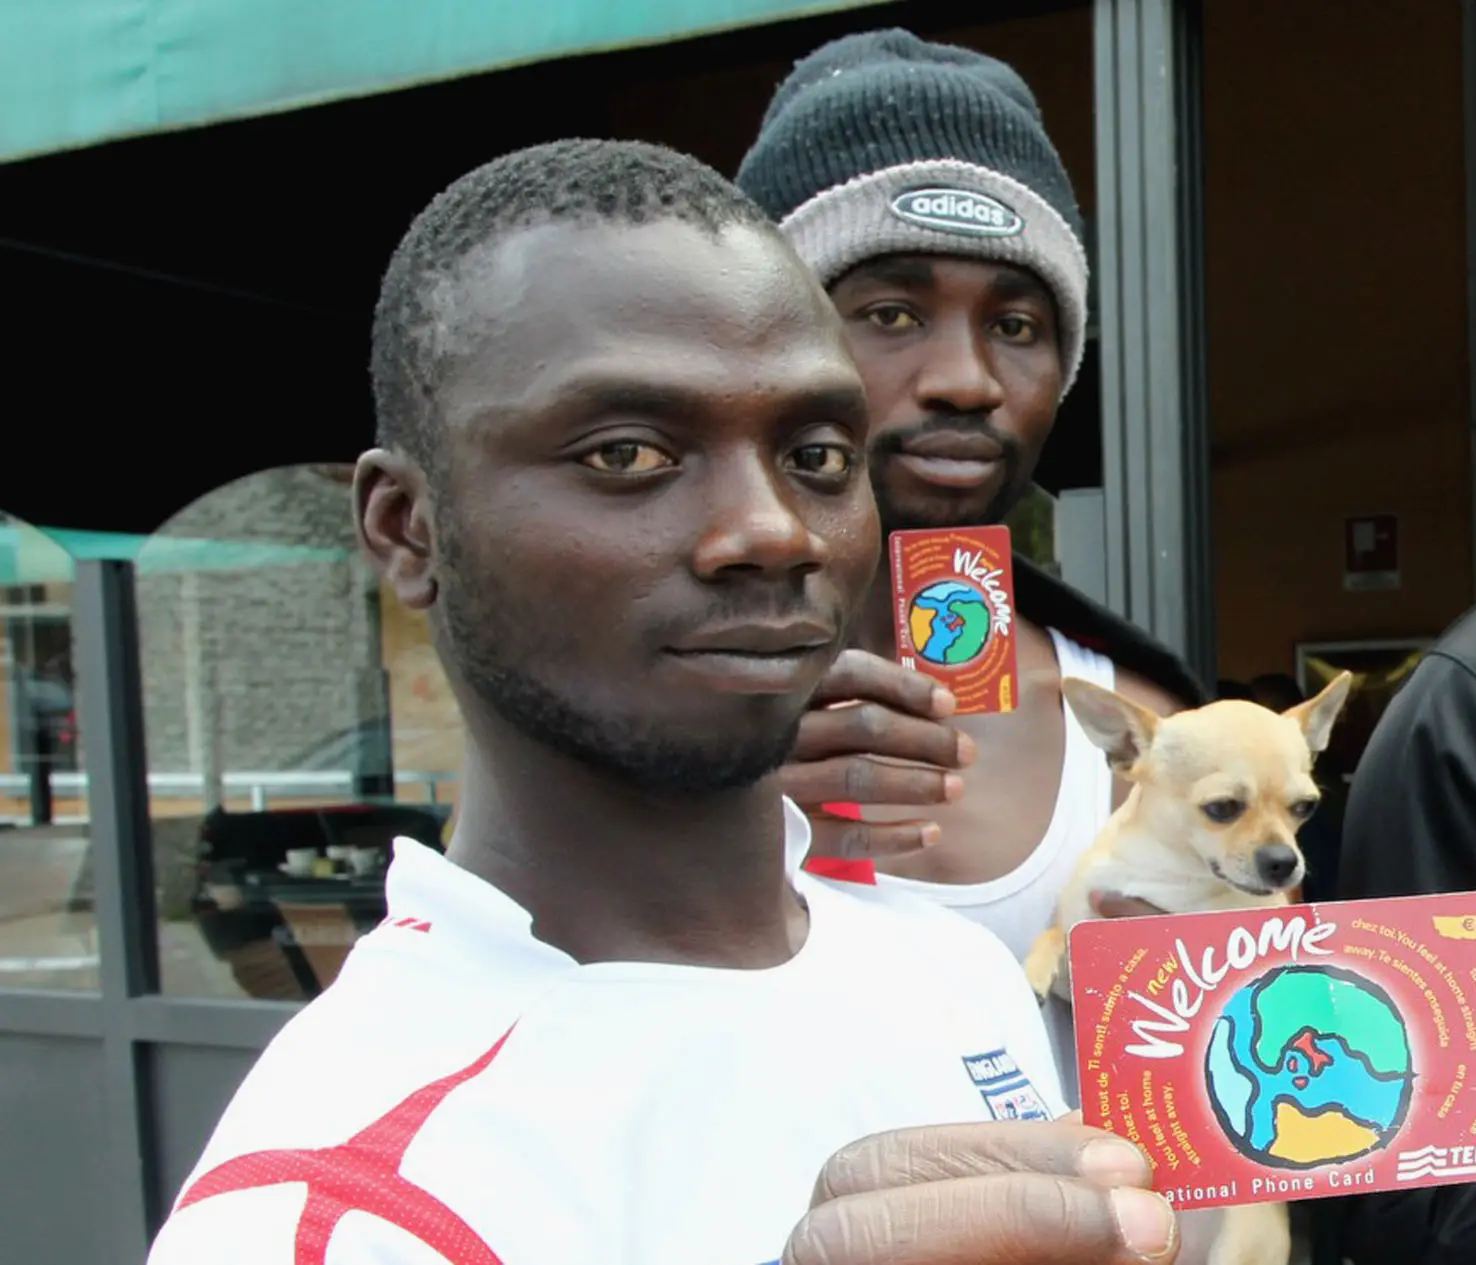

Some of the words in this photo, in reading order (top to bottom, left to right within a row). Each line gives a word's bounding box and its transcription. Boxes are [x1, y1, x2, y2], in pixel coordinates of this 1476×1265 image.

[911, 195, 1004, 226] adidas
[953, 547, 1012, 637] Welcome
[1146, 950, 1178, 996] new
[1352, 918, 1378, 933] chez
[1417, 944, 1438, 964] feel
[1434, 962, 1447, 975] at
[1444, 971, 1466, 1004] home
[1124, 915, 1338, 1059] Welcome
[1378, 949, 1391, 964] Te
[1392, 960, 1427, 990] sientes
[1424, 989, 1450, 1048] enseguida
[1102, 984, 1122, 1022] subito
[1096, 1071, 1109, 1088] de
[1451, 1081, 1463, 1094] tu
[1456, 1064, 1467, 1080] en
[1098, 1090, 1111, 1117] tout
[1142, 1070, 1153, 1107] home
[1145, 1108, 1157, 1122] at
[1437, 1094, 1456, 1119] casa
[1123, 1113, 1141, 1142] chez
[1149, 1122, 1167, 1146] feel
[1170, 1120, 1201, 1165] straight
[1163, 1145, 1180, 1170] You
[1165, 1180, 1237, 1203] ational
[1252, 1175, 1315, 1194] Phone
[1329, 1167, 1375, 1188] Card
